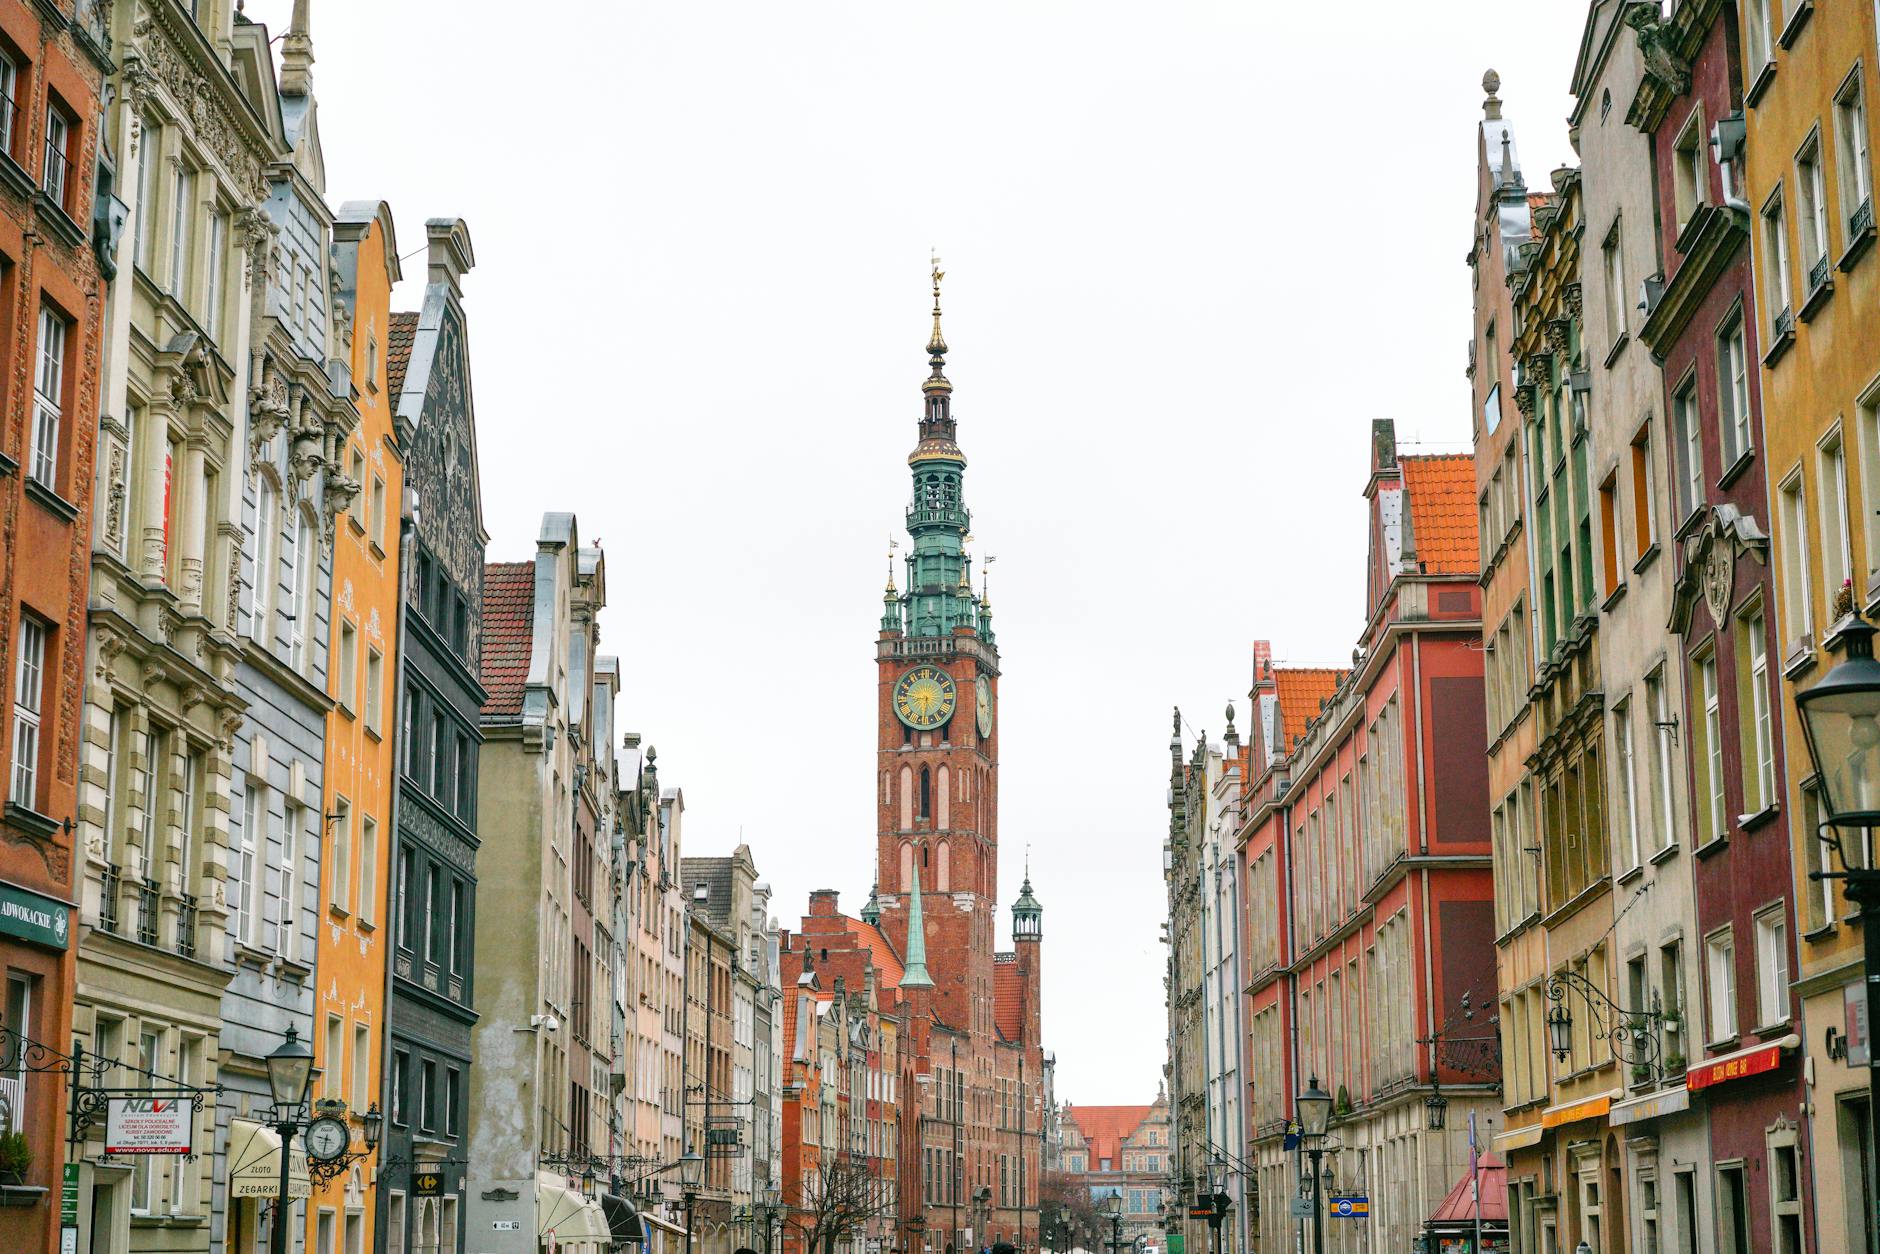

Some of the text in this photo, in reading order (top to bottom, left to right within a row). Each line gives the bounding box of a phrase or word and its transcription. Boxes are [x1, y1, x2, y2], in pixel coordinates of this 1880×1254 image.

[933, 672, 940, 681] I
[1, 901, 52, 929] ADWOKACKIE
[122, 1099, 179, 1113] NOVA
[251, 1166, 271, 1174] ZŁOTO
[239, 1185, 278, 1194] ZEGARKI
